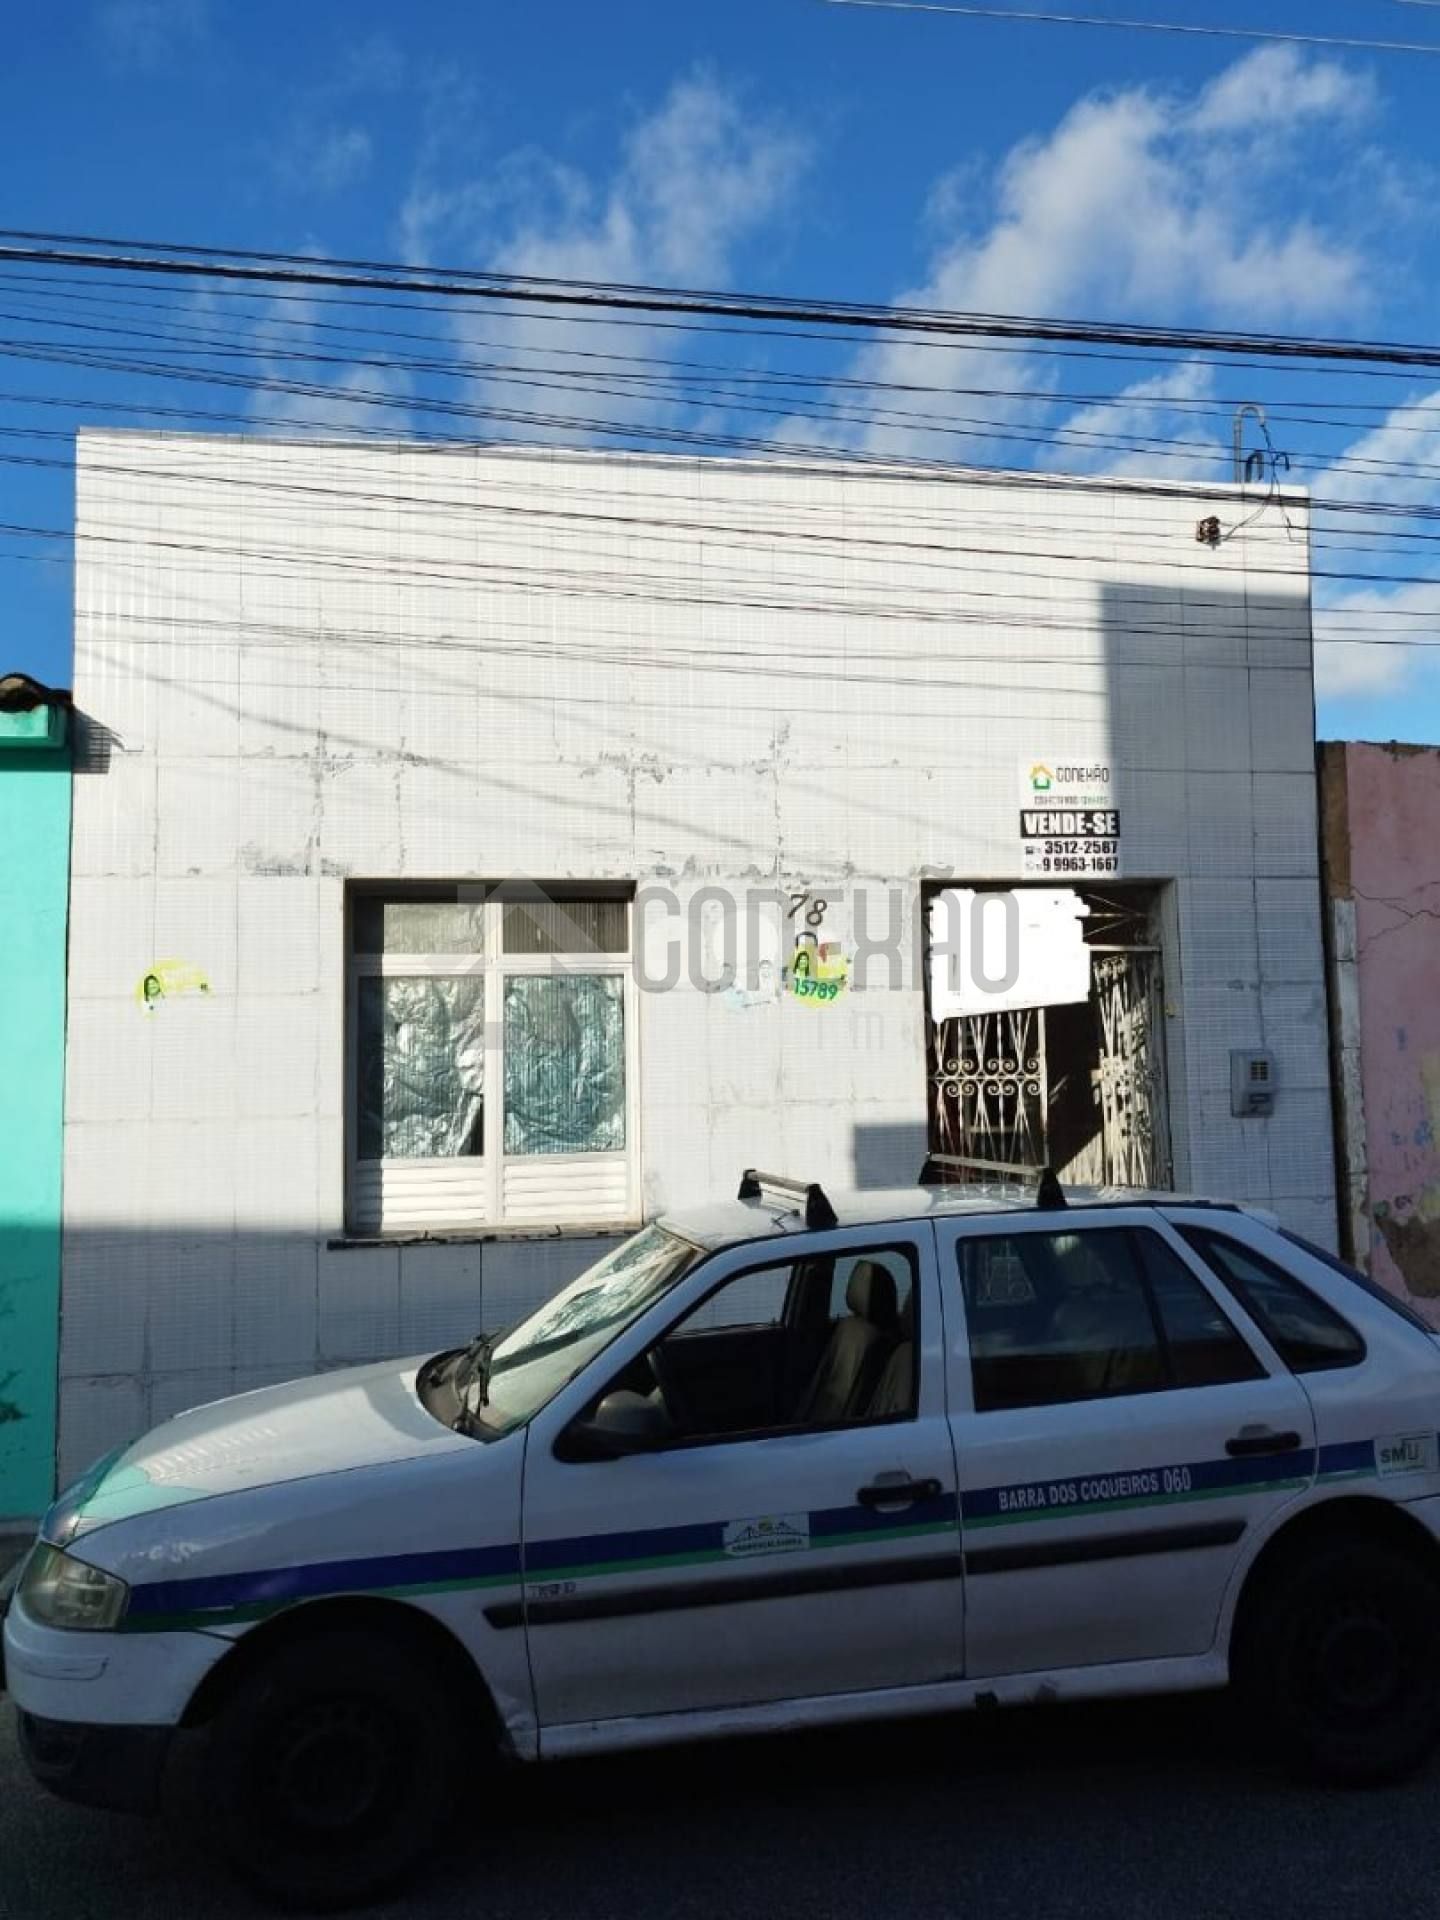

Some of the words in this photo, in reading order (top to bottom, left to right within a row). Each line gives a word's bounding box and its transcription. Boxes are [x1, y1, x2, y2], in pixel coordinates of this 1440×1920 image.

[1023, 812, 1117, 835] VENDE-SE
[1043, 857, 1050, 871] 9
[787, 893, 828, 927] 78
[793, 977, 839, 1000] 15789
[998, 1487, 1046, 1510] BARRA
[1049, 1483, 1077, 1504] DOS
[1080, 1473, 1159, 1500] COQUEIROS
[1163, 1467, 1192, 1492] 060
